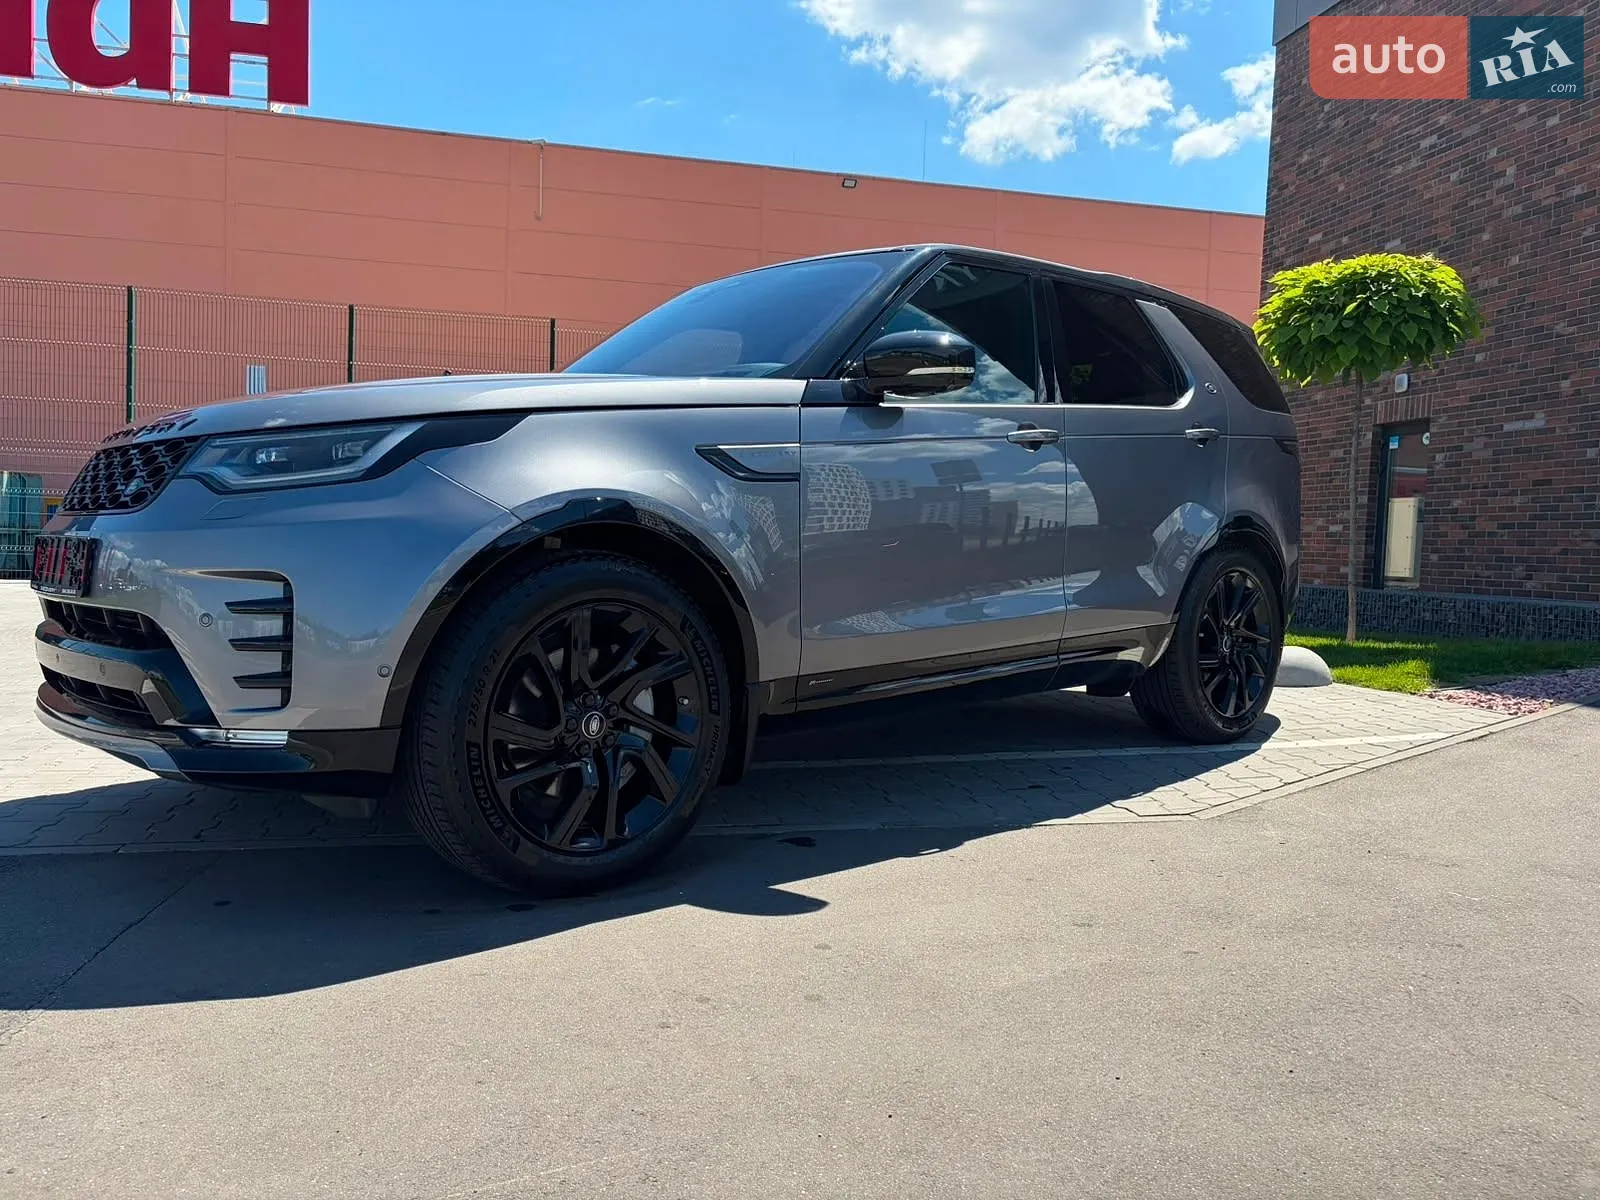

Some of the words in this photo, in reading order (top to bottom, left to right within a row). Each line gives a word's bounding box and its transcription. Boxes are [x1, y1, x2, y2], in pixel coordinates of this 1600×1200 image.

[0, 0, 309, 105] ан
[694, 640, 720, 711] MICHELIN
[469, 745, 506, 829] MICHELIN
